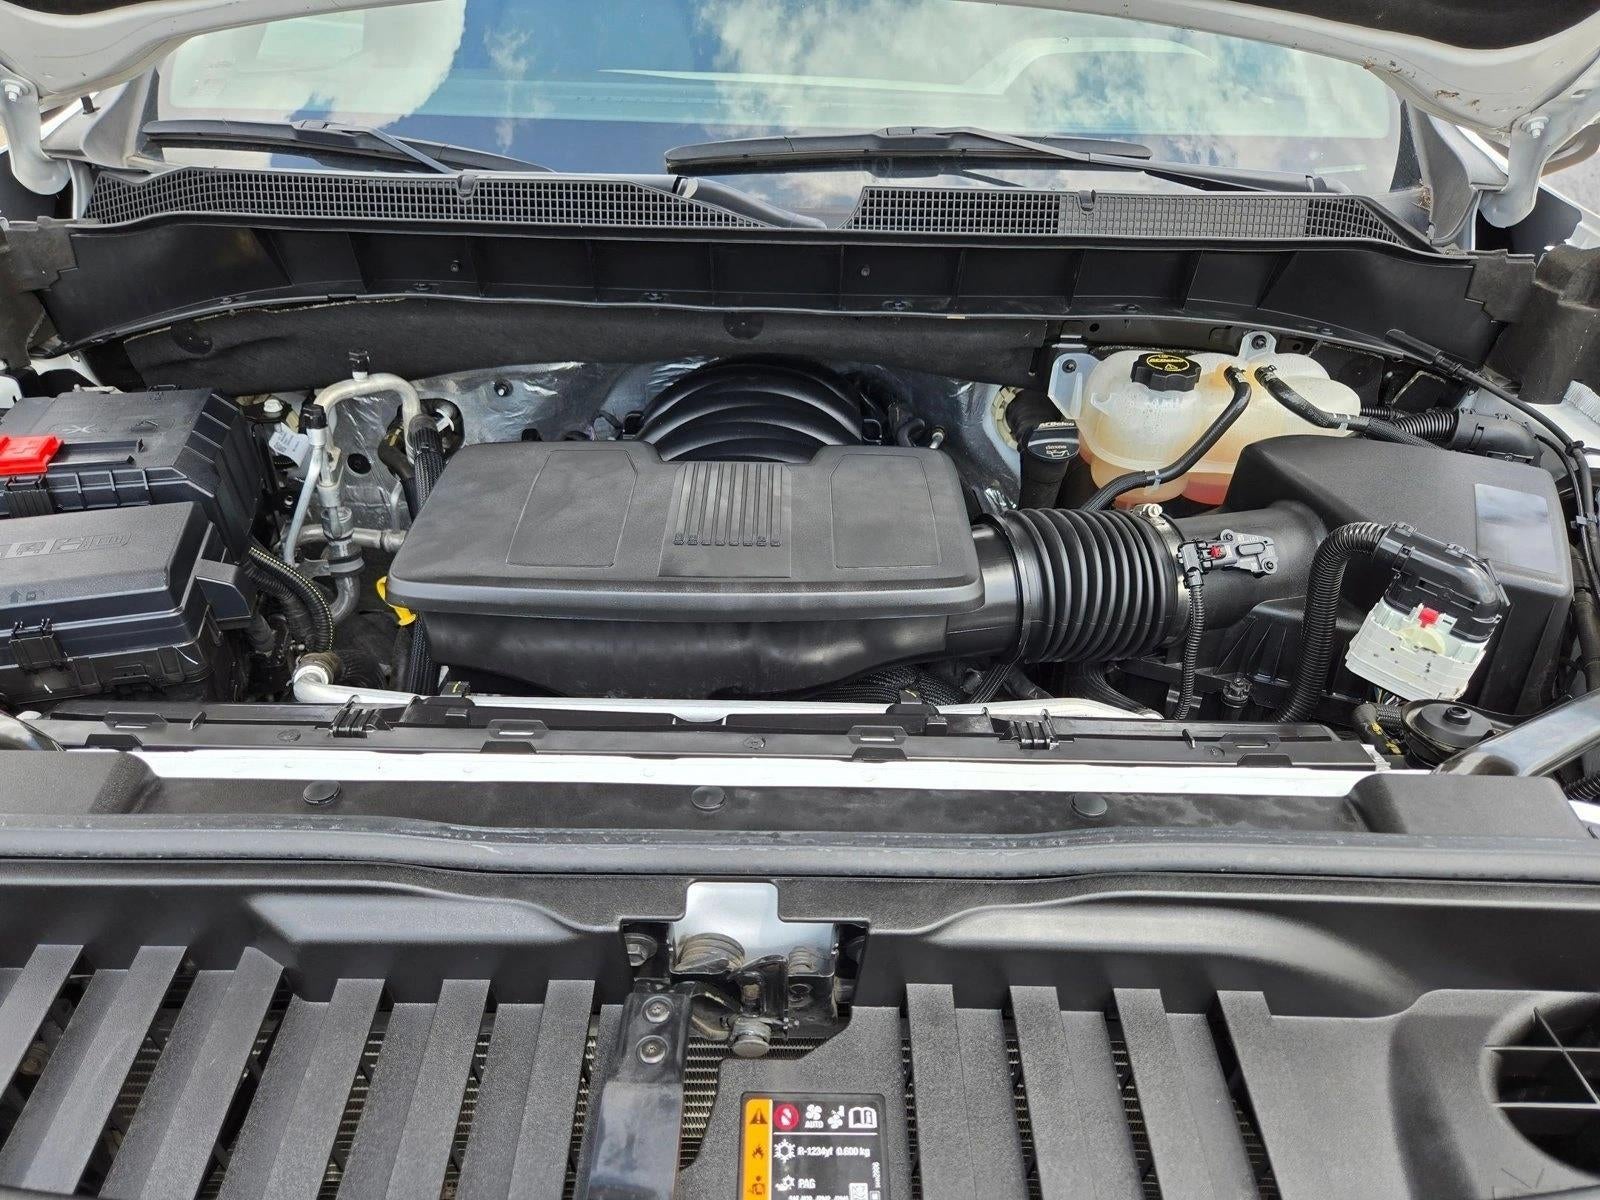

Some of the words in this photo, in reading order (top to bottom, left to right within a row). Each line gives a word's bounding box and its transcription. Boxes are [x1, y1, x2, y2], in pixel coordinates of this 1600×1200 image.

[1038, 421, 1075, 429] ACDelco
[805, 1120, 824, 1129] AUTO
[860, 1146, 871, 1158] kg
[798, 1178, 816, 1189] PAG
